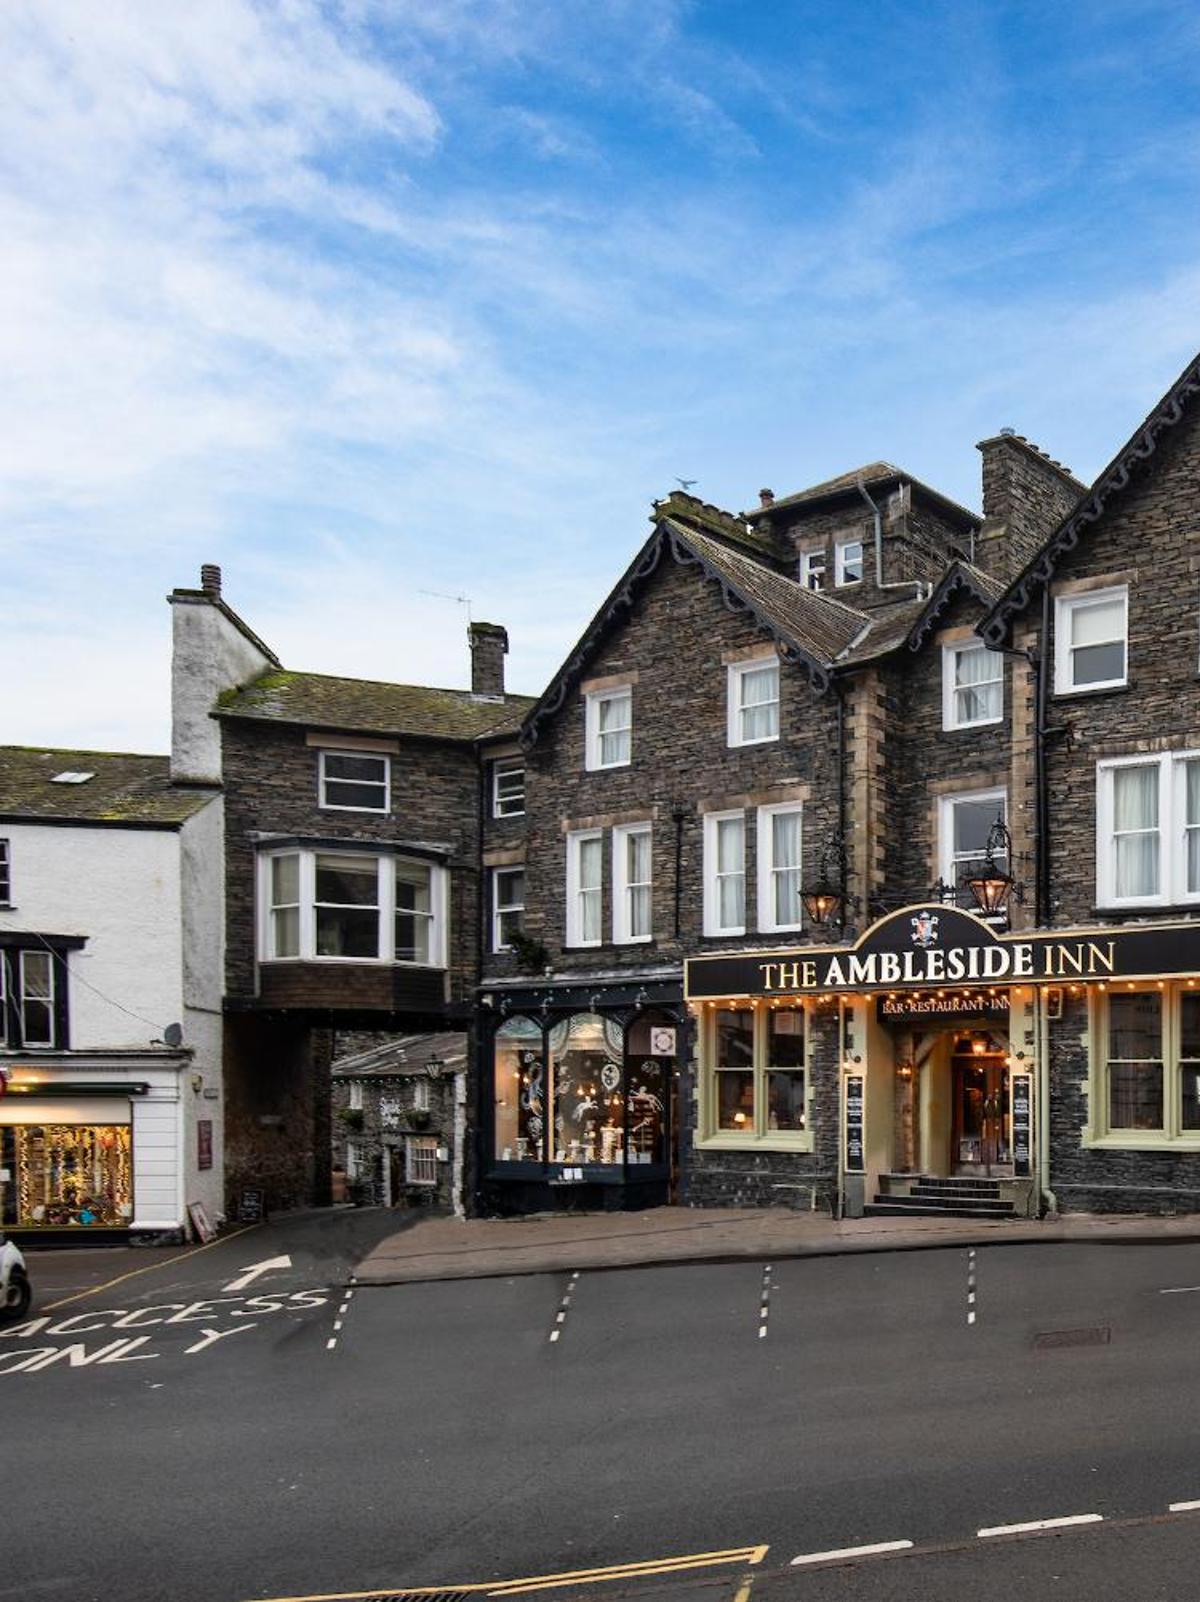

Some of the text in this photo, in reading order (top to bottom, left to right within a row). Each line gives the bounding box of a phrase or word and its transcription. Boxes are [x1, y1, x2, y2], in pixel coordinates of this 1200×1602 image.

[759, 942, 1115, 990] THE AMBLESIDE INN
[0, 1288, 330, 1337] ACCESS
[0, 1323, 258, 1374] ONLY
